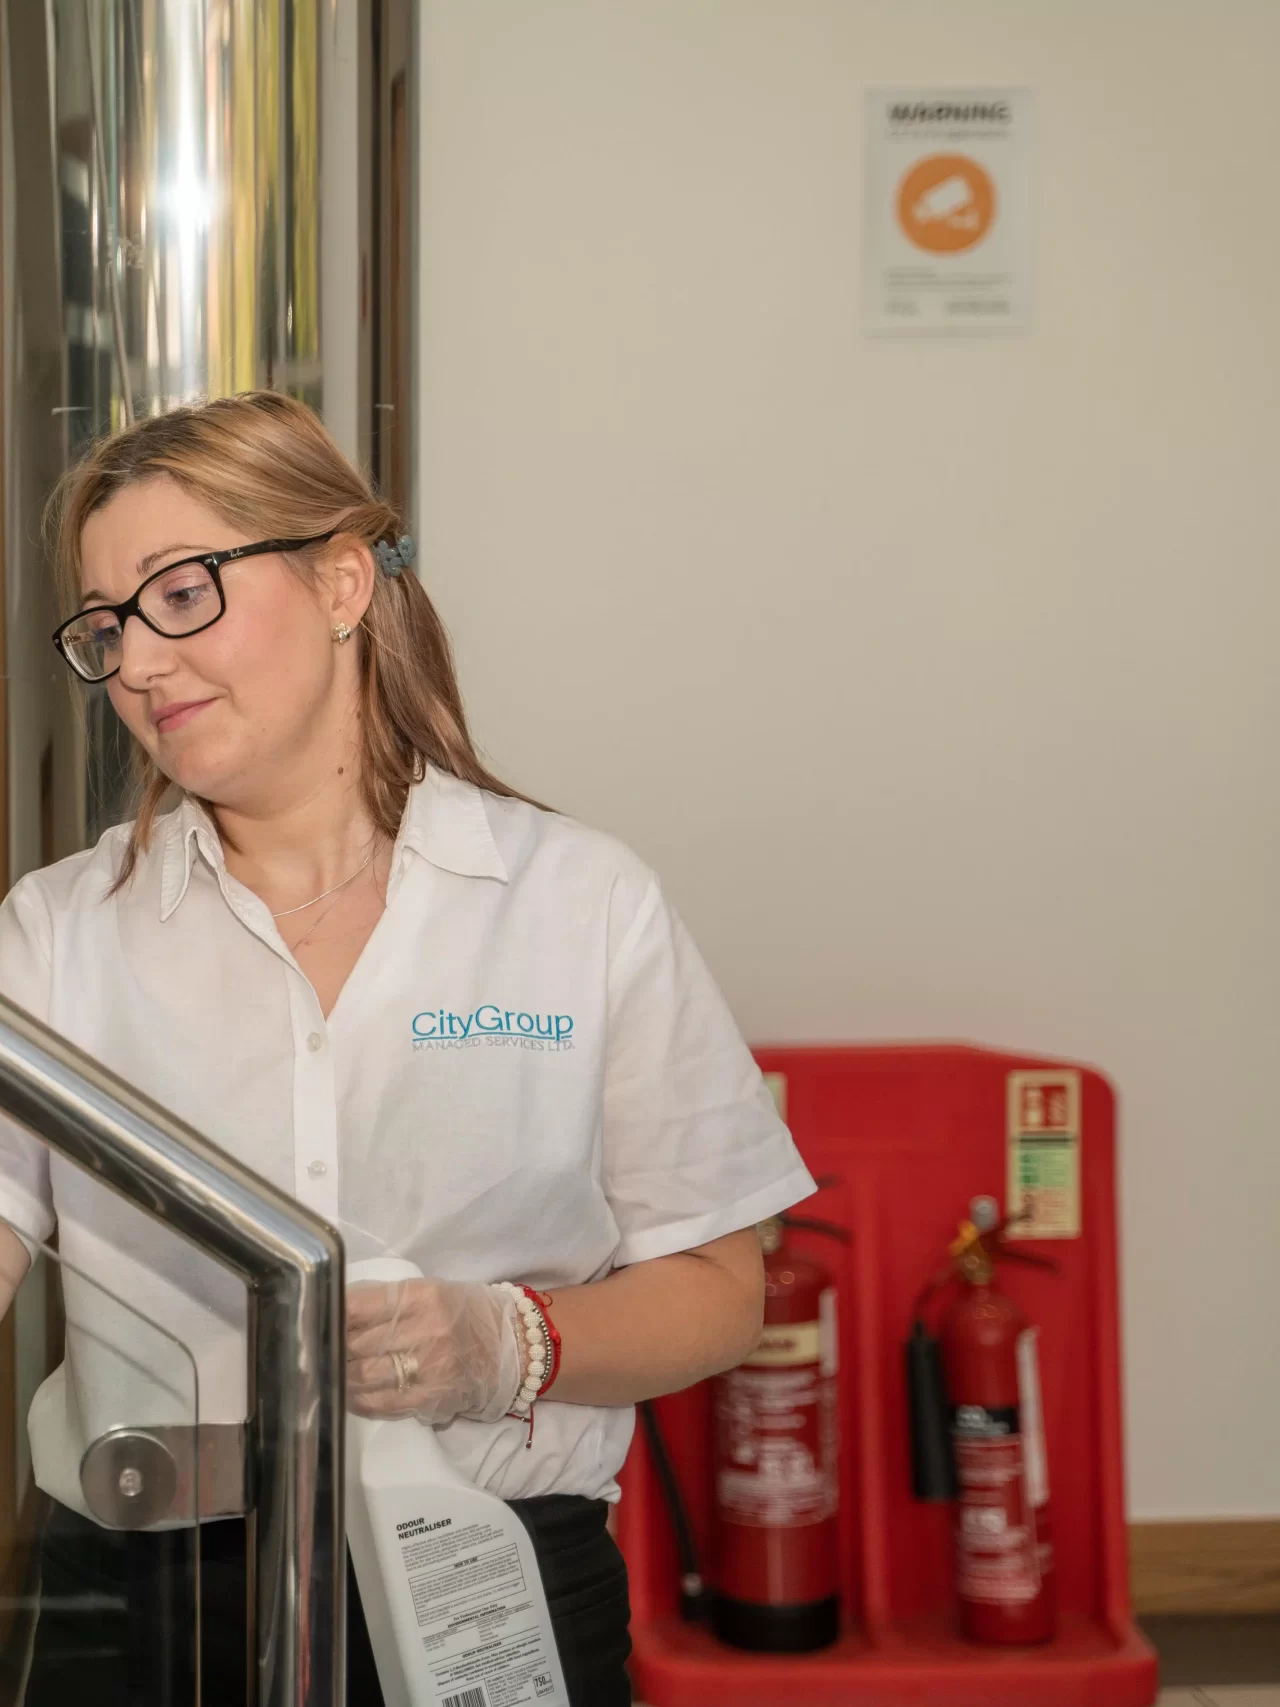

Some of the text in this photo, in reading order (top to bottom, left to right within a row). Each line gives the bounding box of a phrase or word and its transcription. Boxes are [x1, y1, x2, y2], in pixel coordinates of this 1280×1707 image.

[412, 1005, 574, 1042] CityGroup
[412, 1037, 481, 1052] MANAGED
[486, 1036, 544, 1052] SERVICES
[396, 1517, 425, 1531] ODOUR
[398, 1518, 452, 1540] NEUTRALISER
